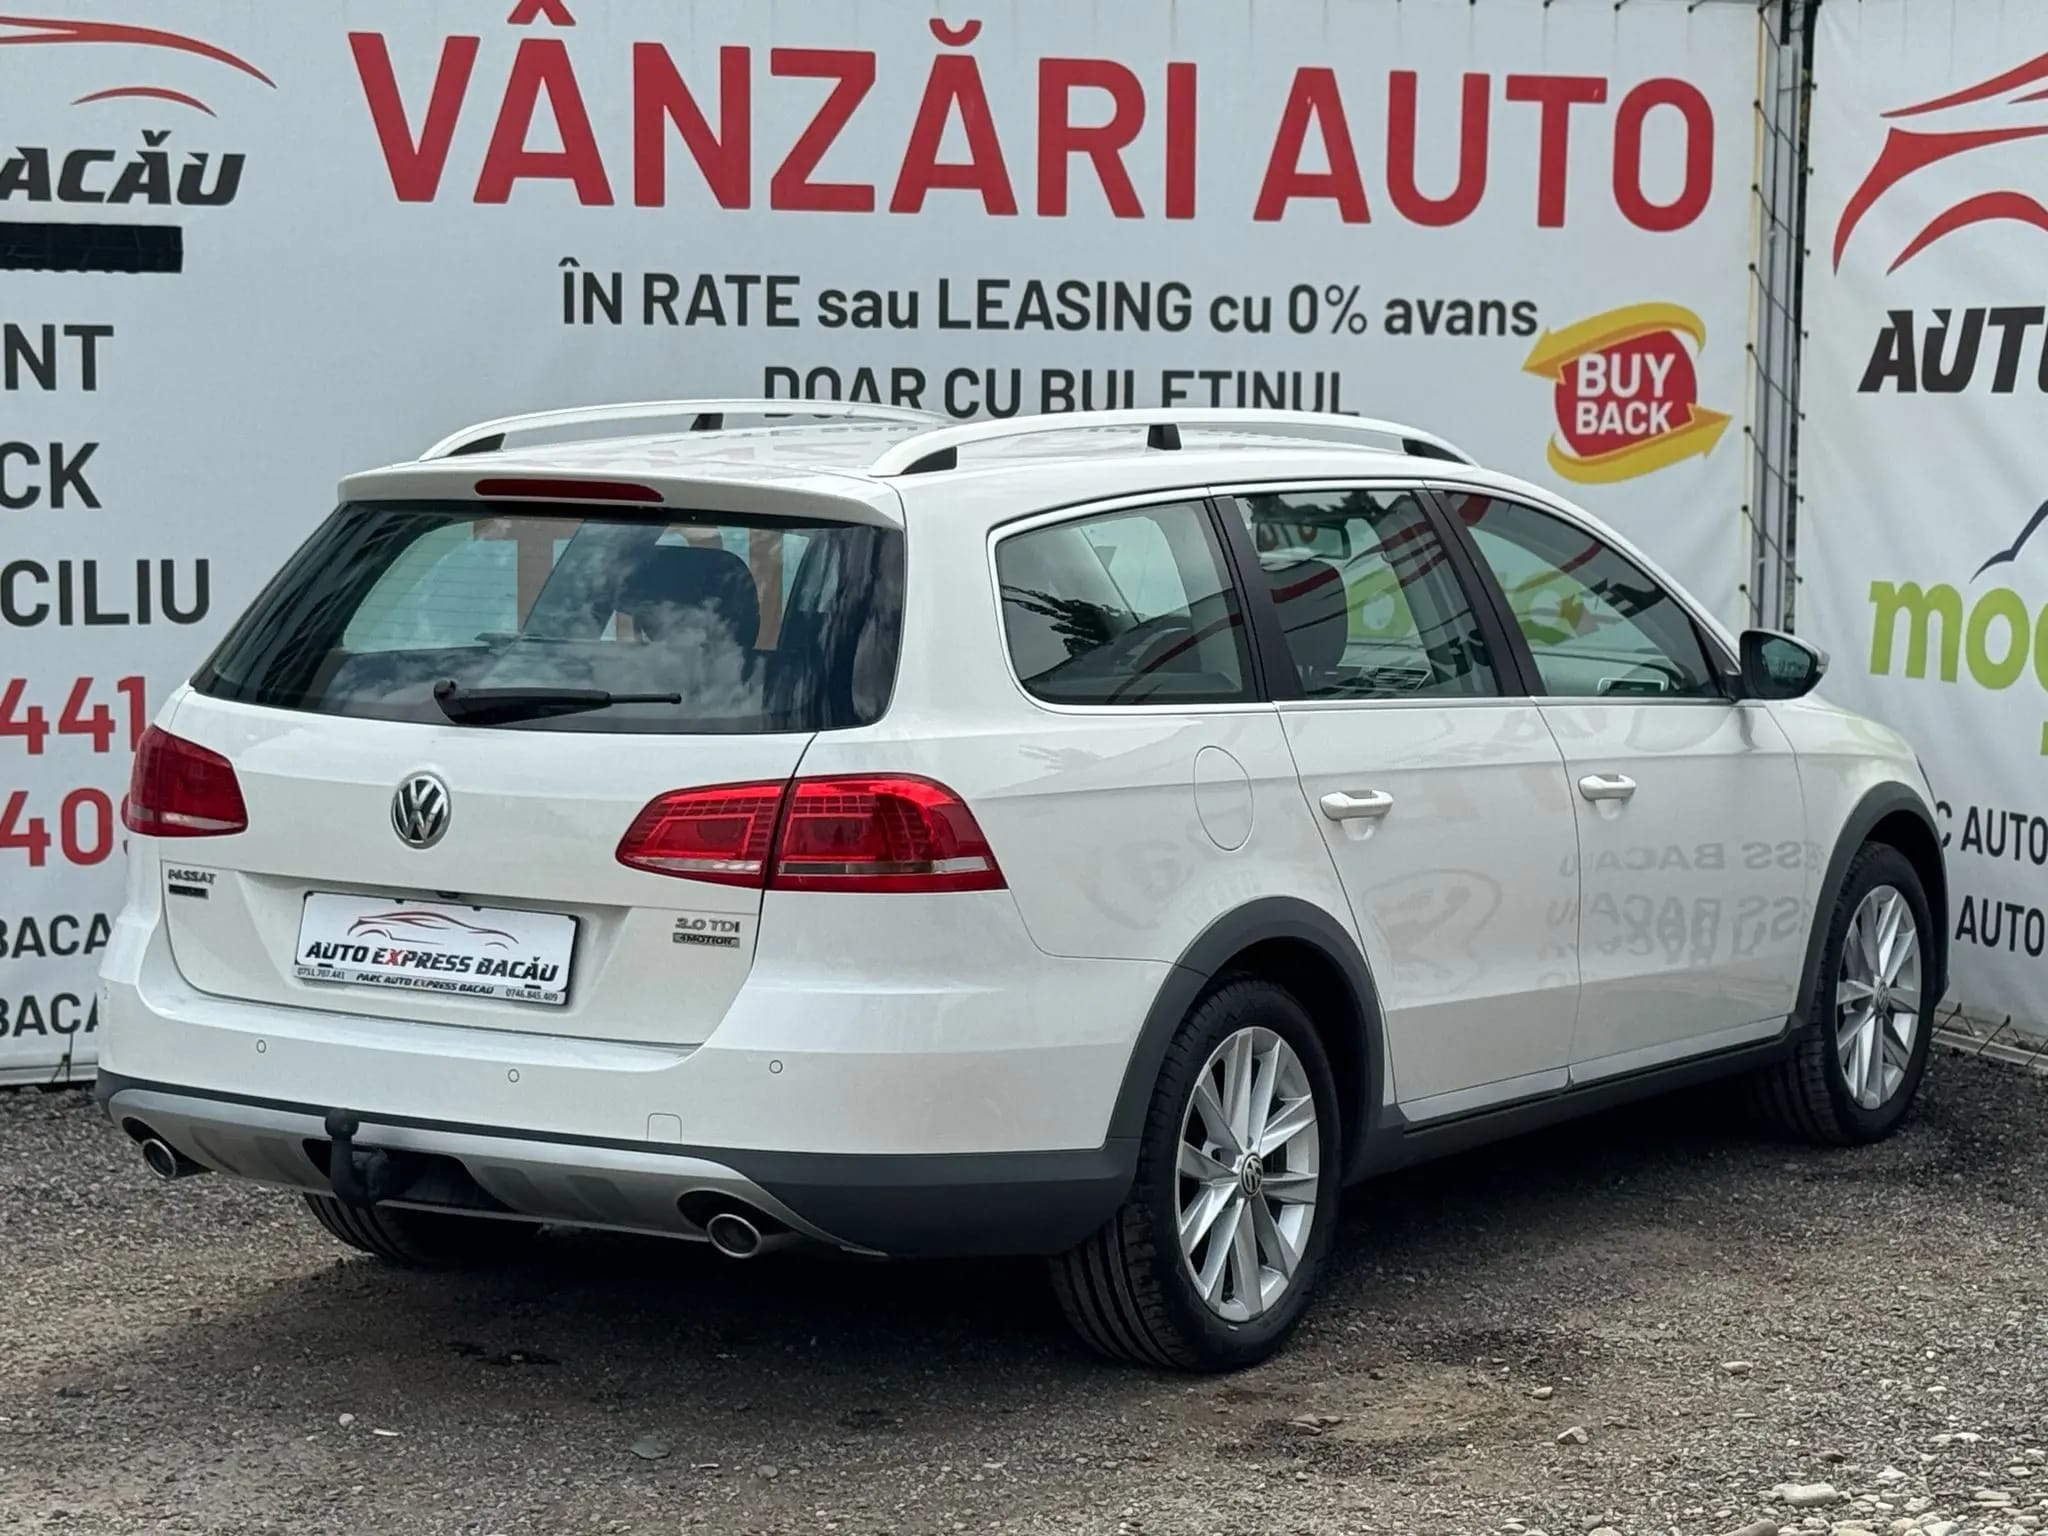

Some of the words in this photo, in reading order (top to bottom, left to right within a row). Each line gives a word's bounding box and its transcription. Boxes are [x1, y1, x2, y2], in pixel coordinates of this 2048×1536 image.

[347, 0, 1197, 220] VÂNZĂRI
[1253, 66, 1715, 232] AUTO
[558, 256, 623, 325] ÎN
[643, 272, 801, 328] RATE
[817, 287, 919, 330] sau
[938, 278, 1192, 333] LEASING
[1209, 295, 1272, 334] cu
[1288, 283, 1368, 335] 0%
[1383, 297, 1538, 337] avans
[1576, 352, 1676, 398] BUY
[1856, 305, 2048, 393] AUT
[944, 367, 1021, 419] CU
[1575, 400, 1674, 436] BACK
[0, 558, 210, 627] CILIU
[1869, 579, 2048, 692] mo
[0, 787, 129, 867] 40
[1960, 805, 2048, 866] AUTO
[168, 868, 217, 886] PASSAT
[709, 919, 741, 933] TDI
[1954, 894, 2045, 958] AUTO
[305, 940, 370, 963] AUTO
[371, 946, 474, 973] EXPRESS
[475, 956, 560, 982] BACĂU
[384, 975, 412, 987] AUTO
